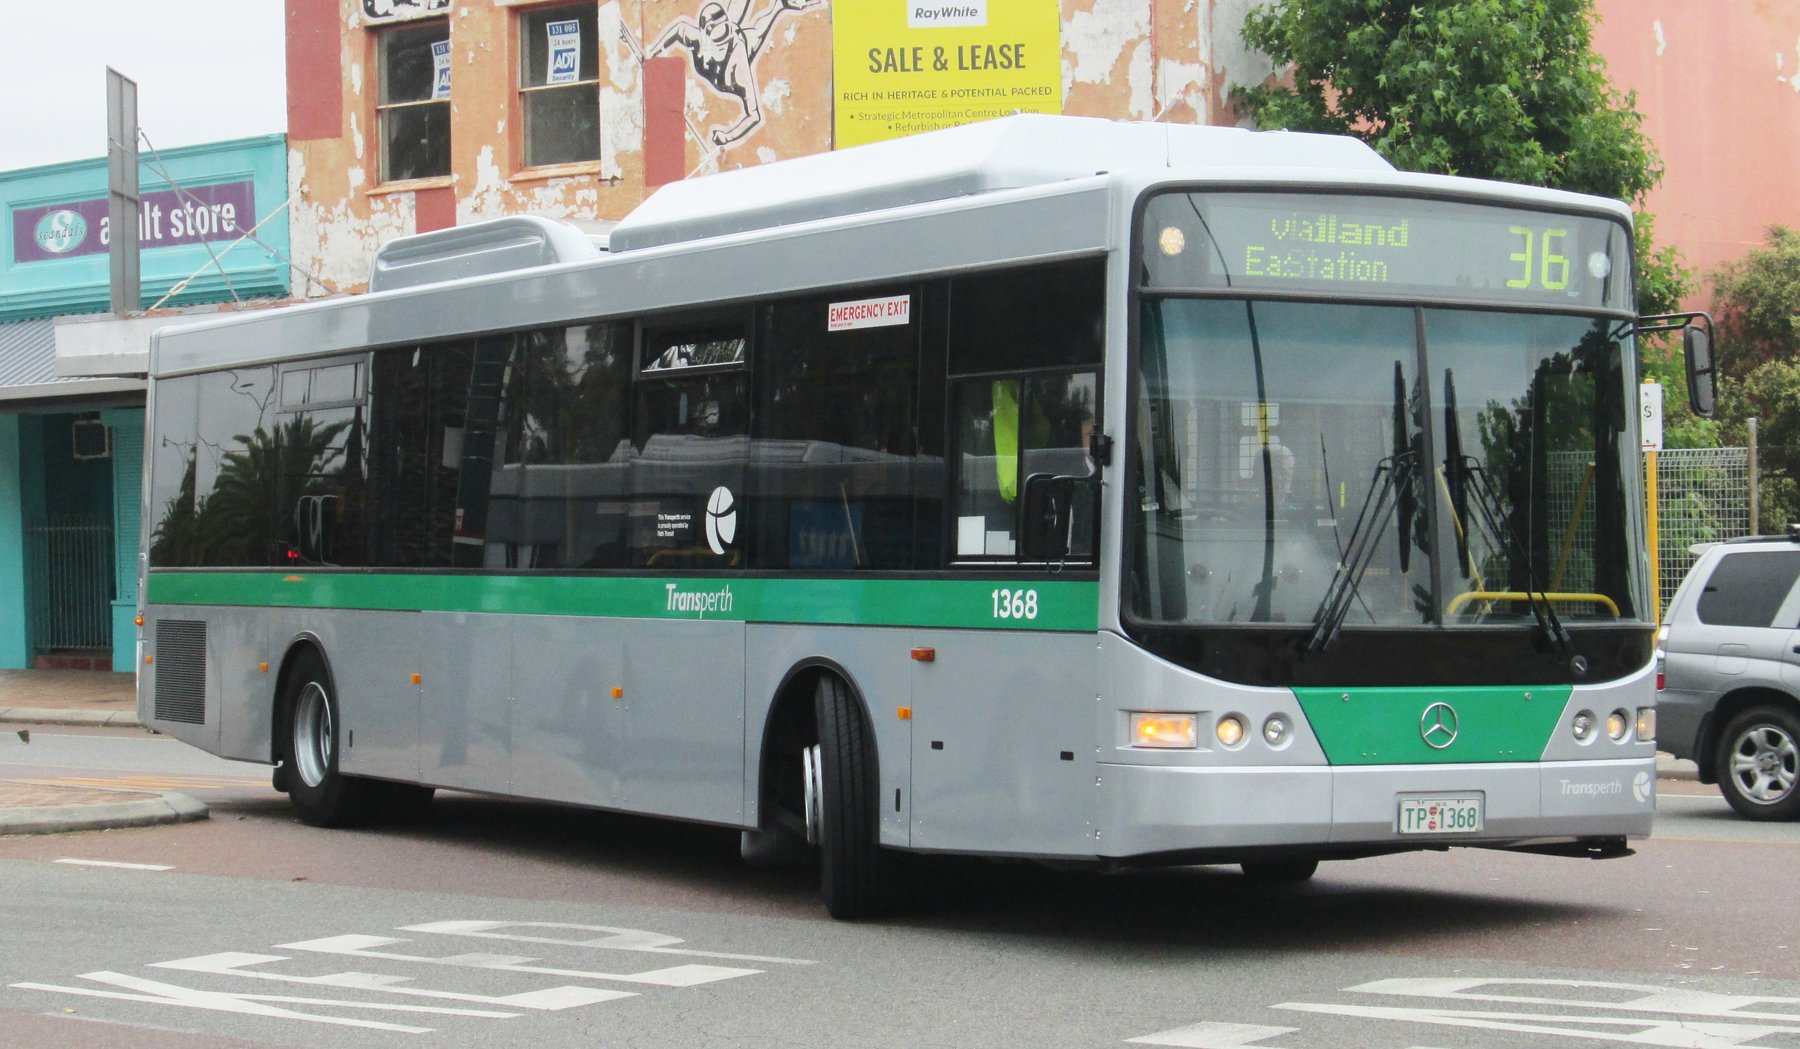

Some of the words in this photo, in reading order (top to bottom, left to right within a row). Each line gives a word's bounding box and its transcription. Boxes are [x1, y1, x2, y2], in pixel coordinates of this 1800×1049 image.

[915, 6, 979, 21] RayWhite
[551, 26, 563, 35] 131
[564, 23, 577, 33] 005
[554, 51, 576, 71] ADT
[868, 47, 924, 74] SALE
[932, 45, 949, 72] &
[958, 43, 1026, 71] LEASE
[843, 92, 868, 101] RICH
[872, 91, 884, 100] IN
[887, 90, 937, 99] HERITAGE
[941, 90, 948, 98] &
[950, 88, 1007, 98] POTENTIAL
[1011, 87, 1052, 96] PACKED
[858, 111, 900, 122] Strategic
[902, 109, 963, 120] Metropolitan
[964, 108, 998, 118] Centre
[895, 121, 940, 132] Refurbish
[100, 203, 162, 245] alt
[169, 201, 236, 238] store
[1506, 226, 1570, 290] 36
[830, 303, 884, 322] EMERGENCY
[887, 300, 908, 316] EXIT
[666, 584, 733, 619] Transperth
[992, 589, 1038, 619] 1368
[1560, 779, 1622, 799] Transperth
